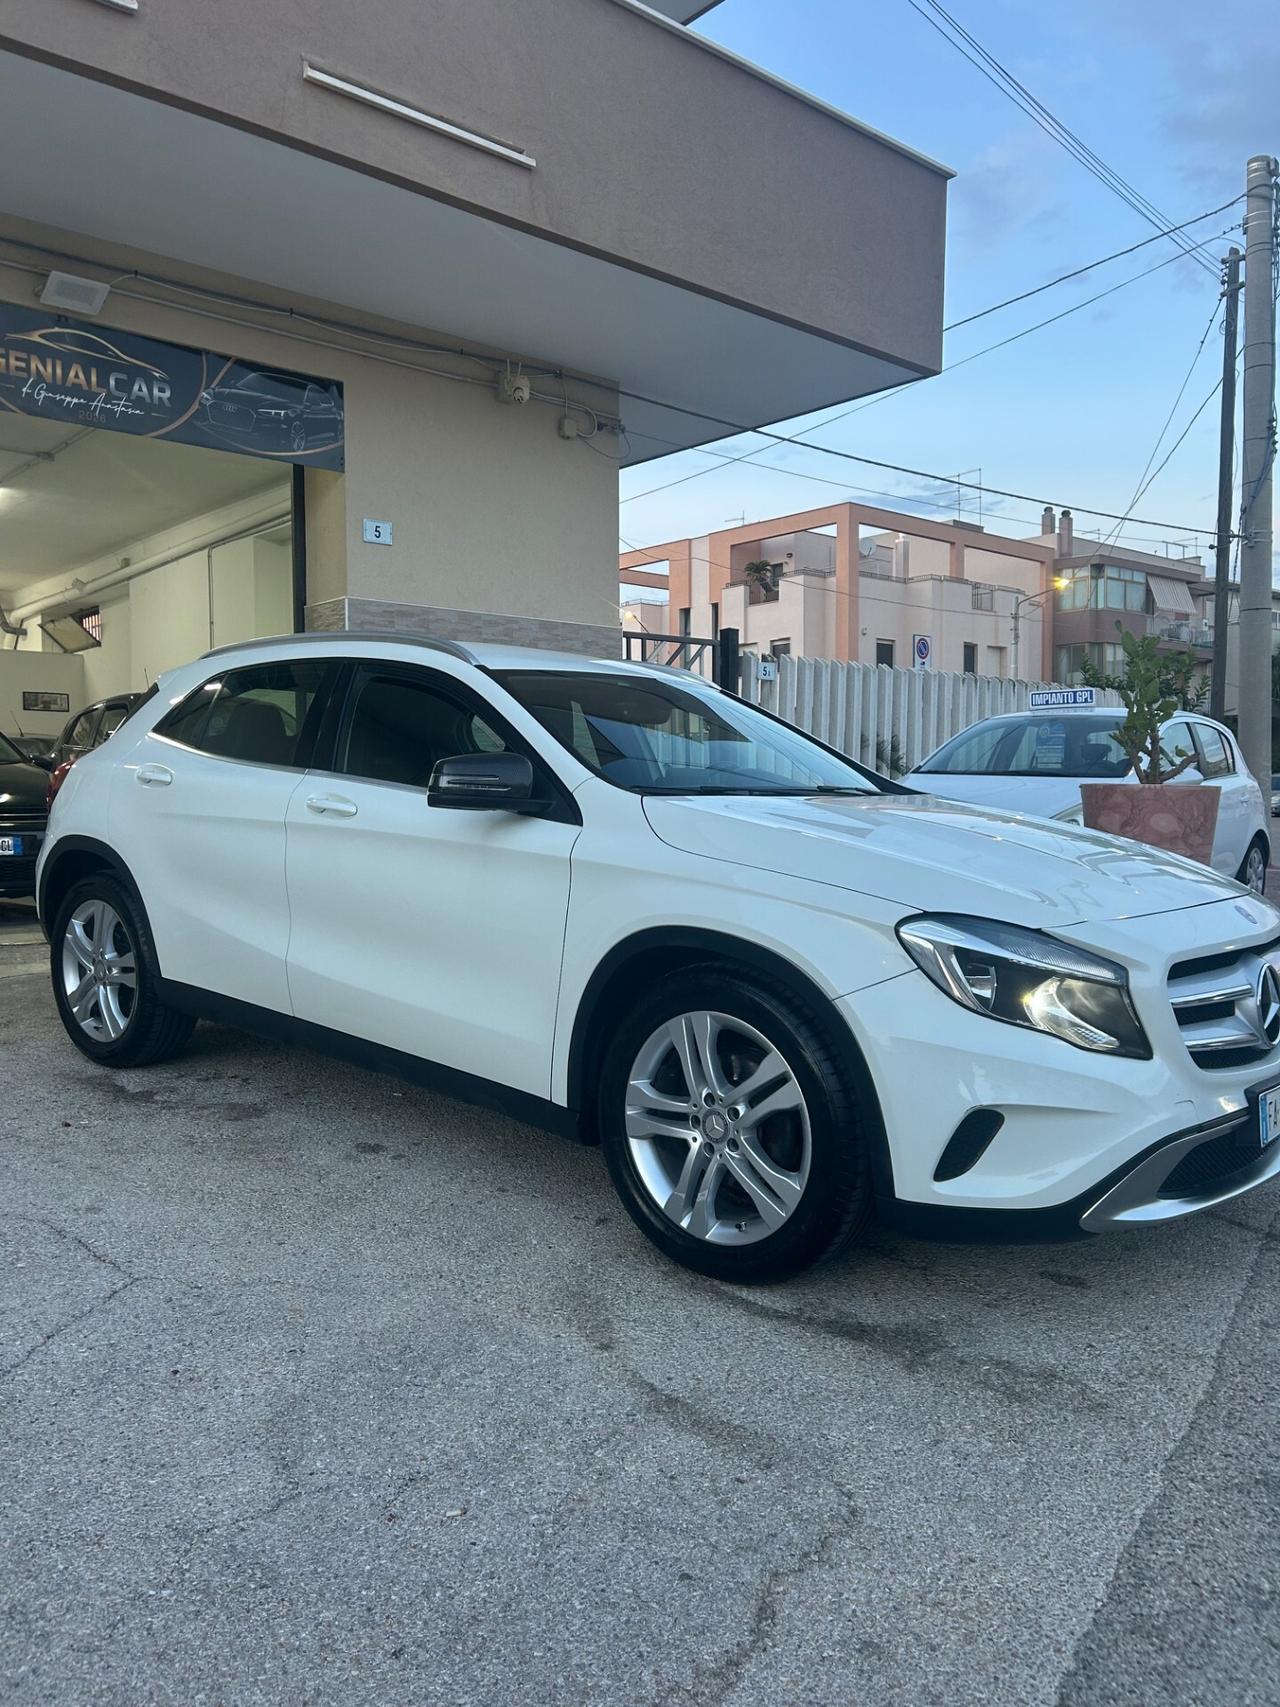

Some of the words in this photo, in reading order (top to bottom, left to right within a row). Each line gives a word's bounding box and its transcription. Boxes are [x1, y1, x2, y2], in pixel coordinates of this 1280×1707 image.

[375, 525, 381, 538] 5
[1032, 692, 1074, 705] IMPIANTO
[1076, 691, 1092, 703] GPL
